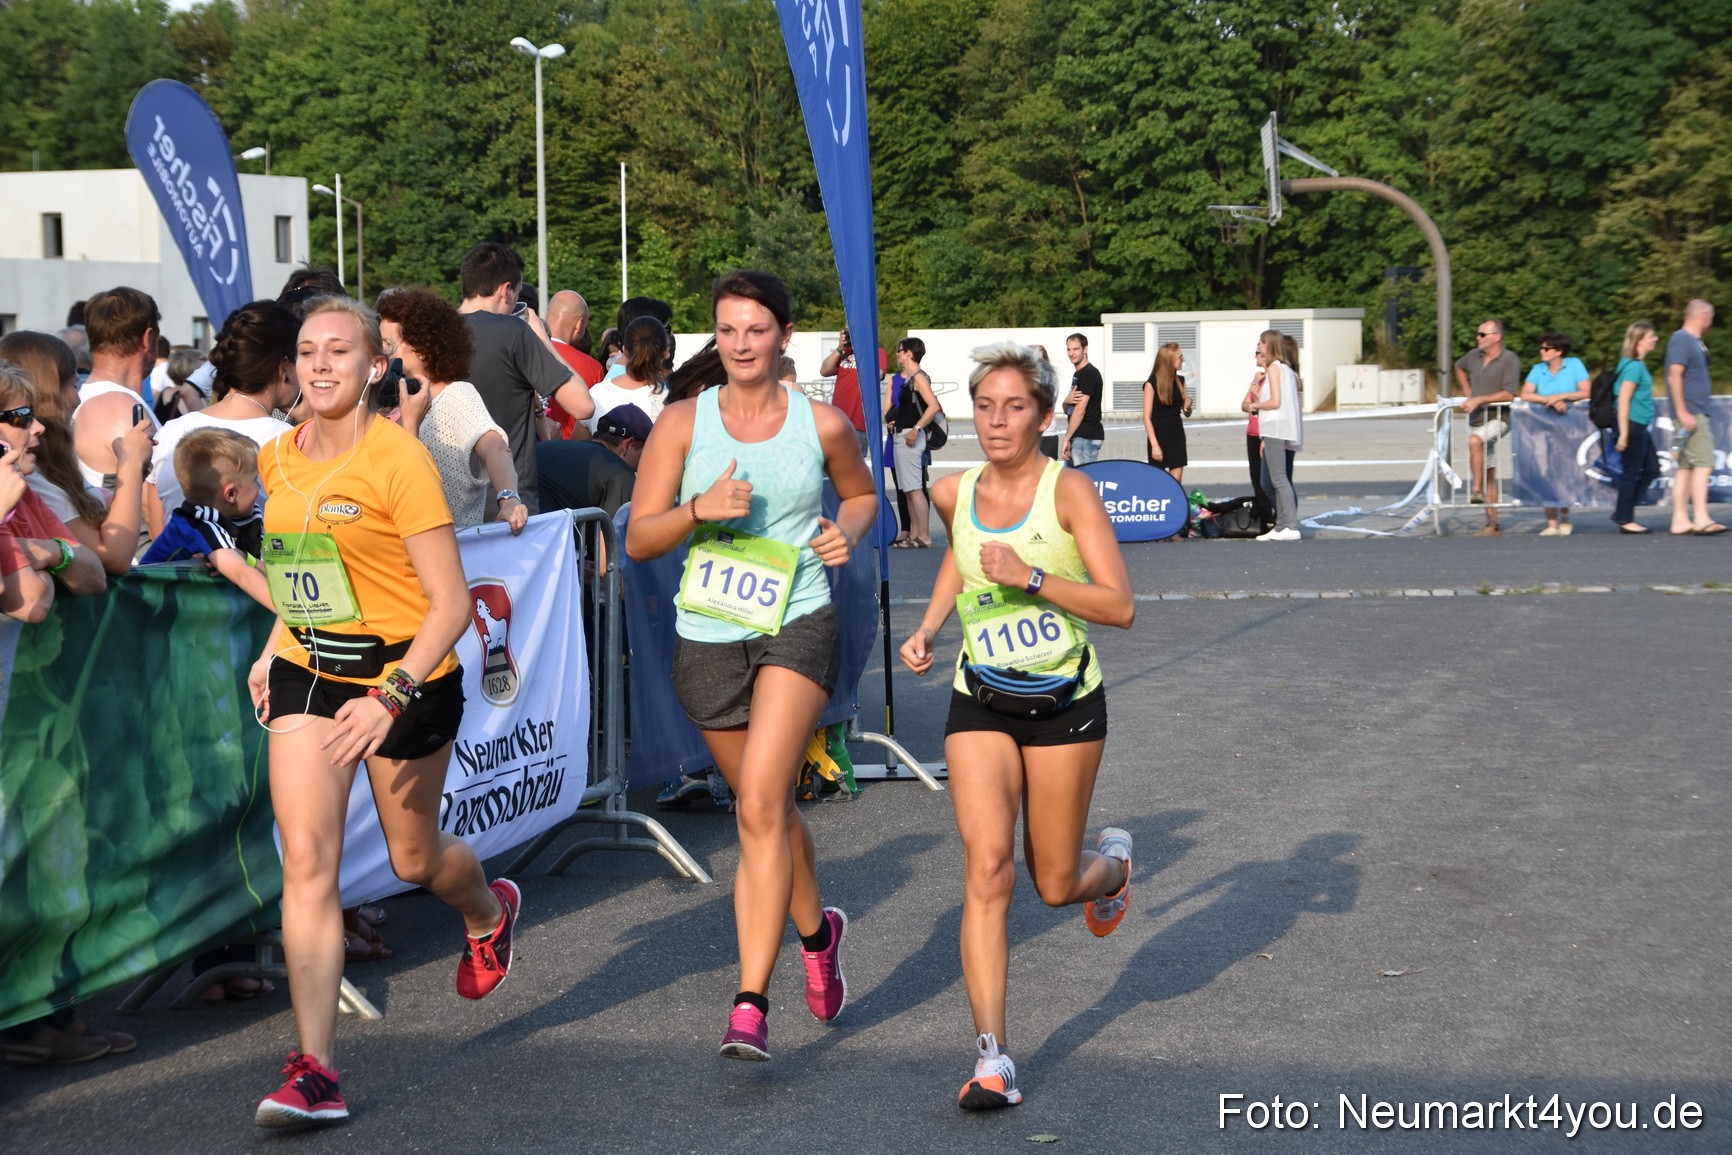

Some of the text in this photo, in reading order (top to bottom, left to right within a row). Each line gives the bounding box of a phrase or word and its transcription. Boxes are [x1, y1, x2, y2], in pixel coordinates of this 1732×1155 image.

[1104, 495, 1171, 514] scher
[1110, 514, 1166, 523] TOMOBILE
[285, 572, 320, 602] 70
[699, 559, 780, 607] 1105
[707, 597, 737, 611] Alexandra
[737, 606, 755, 616] Hiller
[977, 612, 1061, 658] 1106
[996, 658, 1025, 668] Roswitha
[1025, 650, 1053, 661] Scherzer
[487, 674, 512, 696] 1628
[454, 717, 555, 778] Neumarkter
